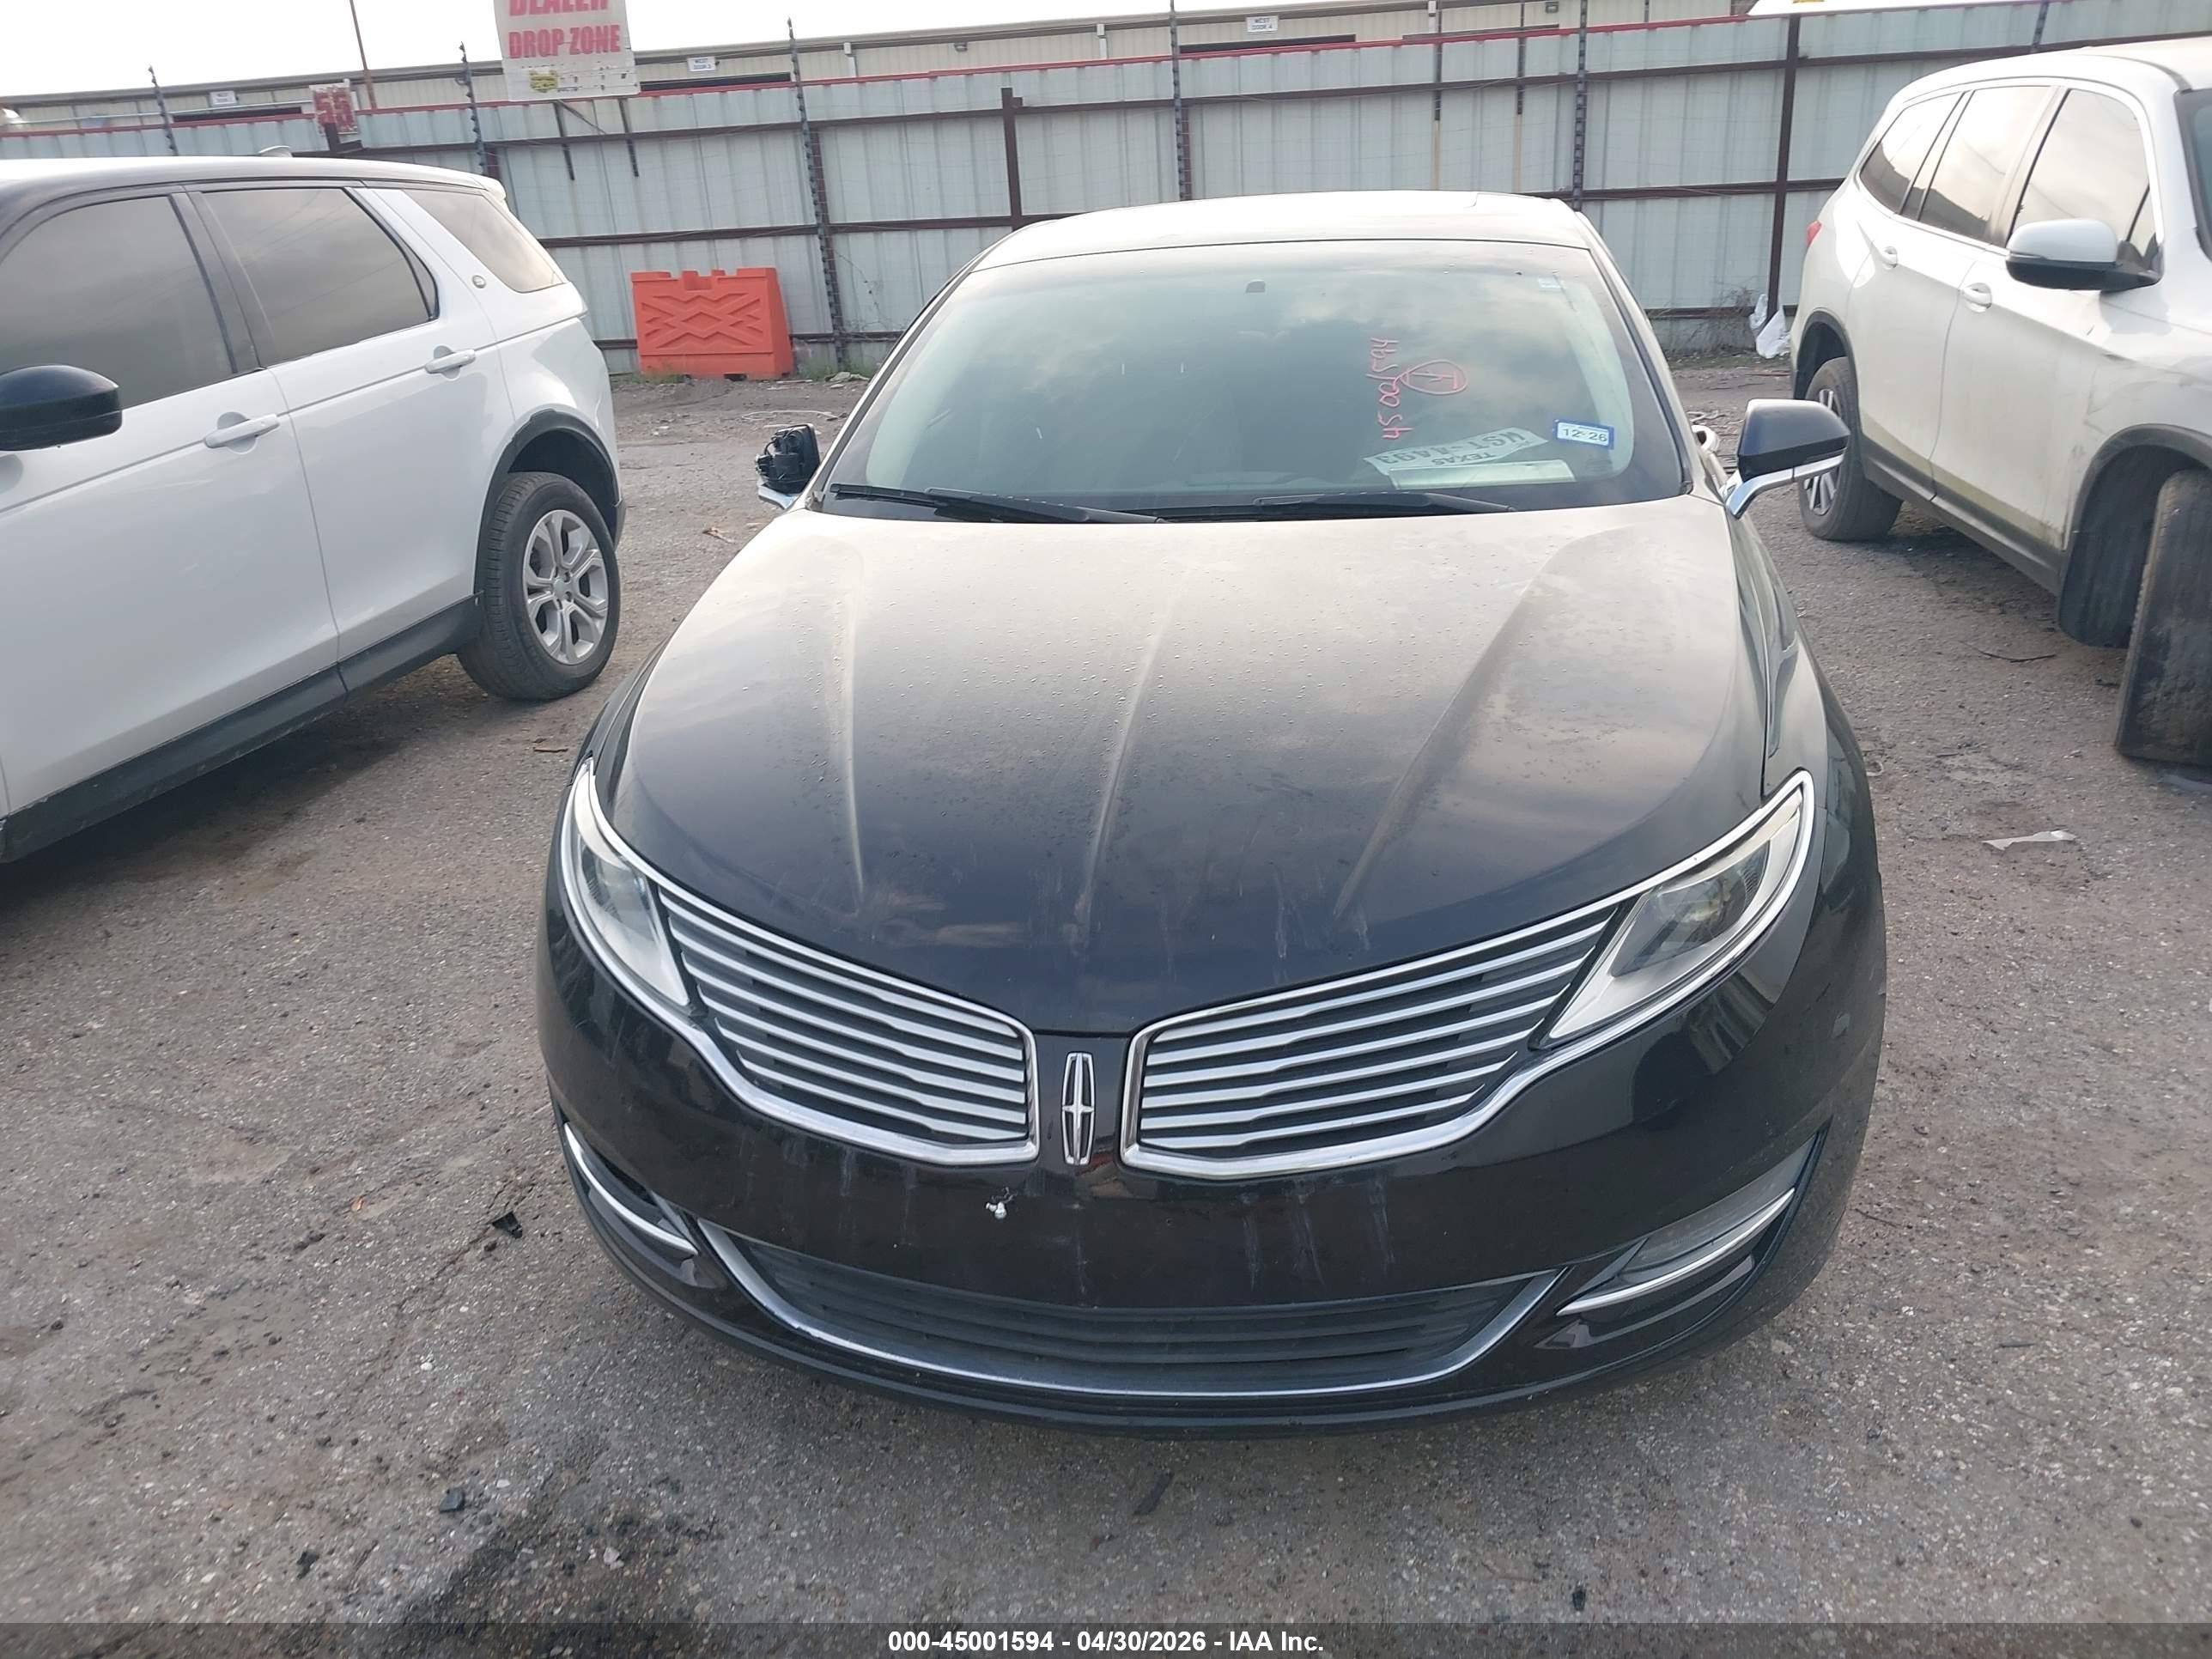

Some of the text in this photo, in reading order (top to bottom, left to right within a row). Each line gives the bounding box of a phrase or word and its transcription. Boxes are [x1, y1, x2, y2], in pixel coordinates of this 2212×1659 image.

[508, 24, 621, 58] DROP ZONE
[1431, 452, 1497, 465] TEXAS
